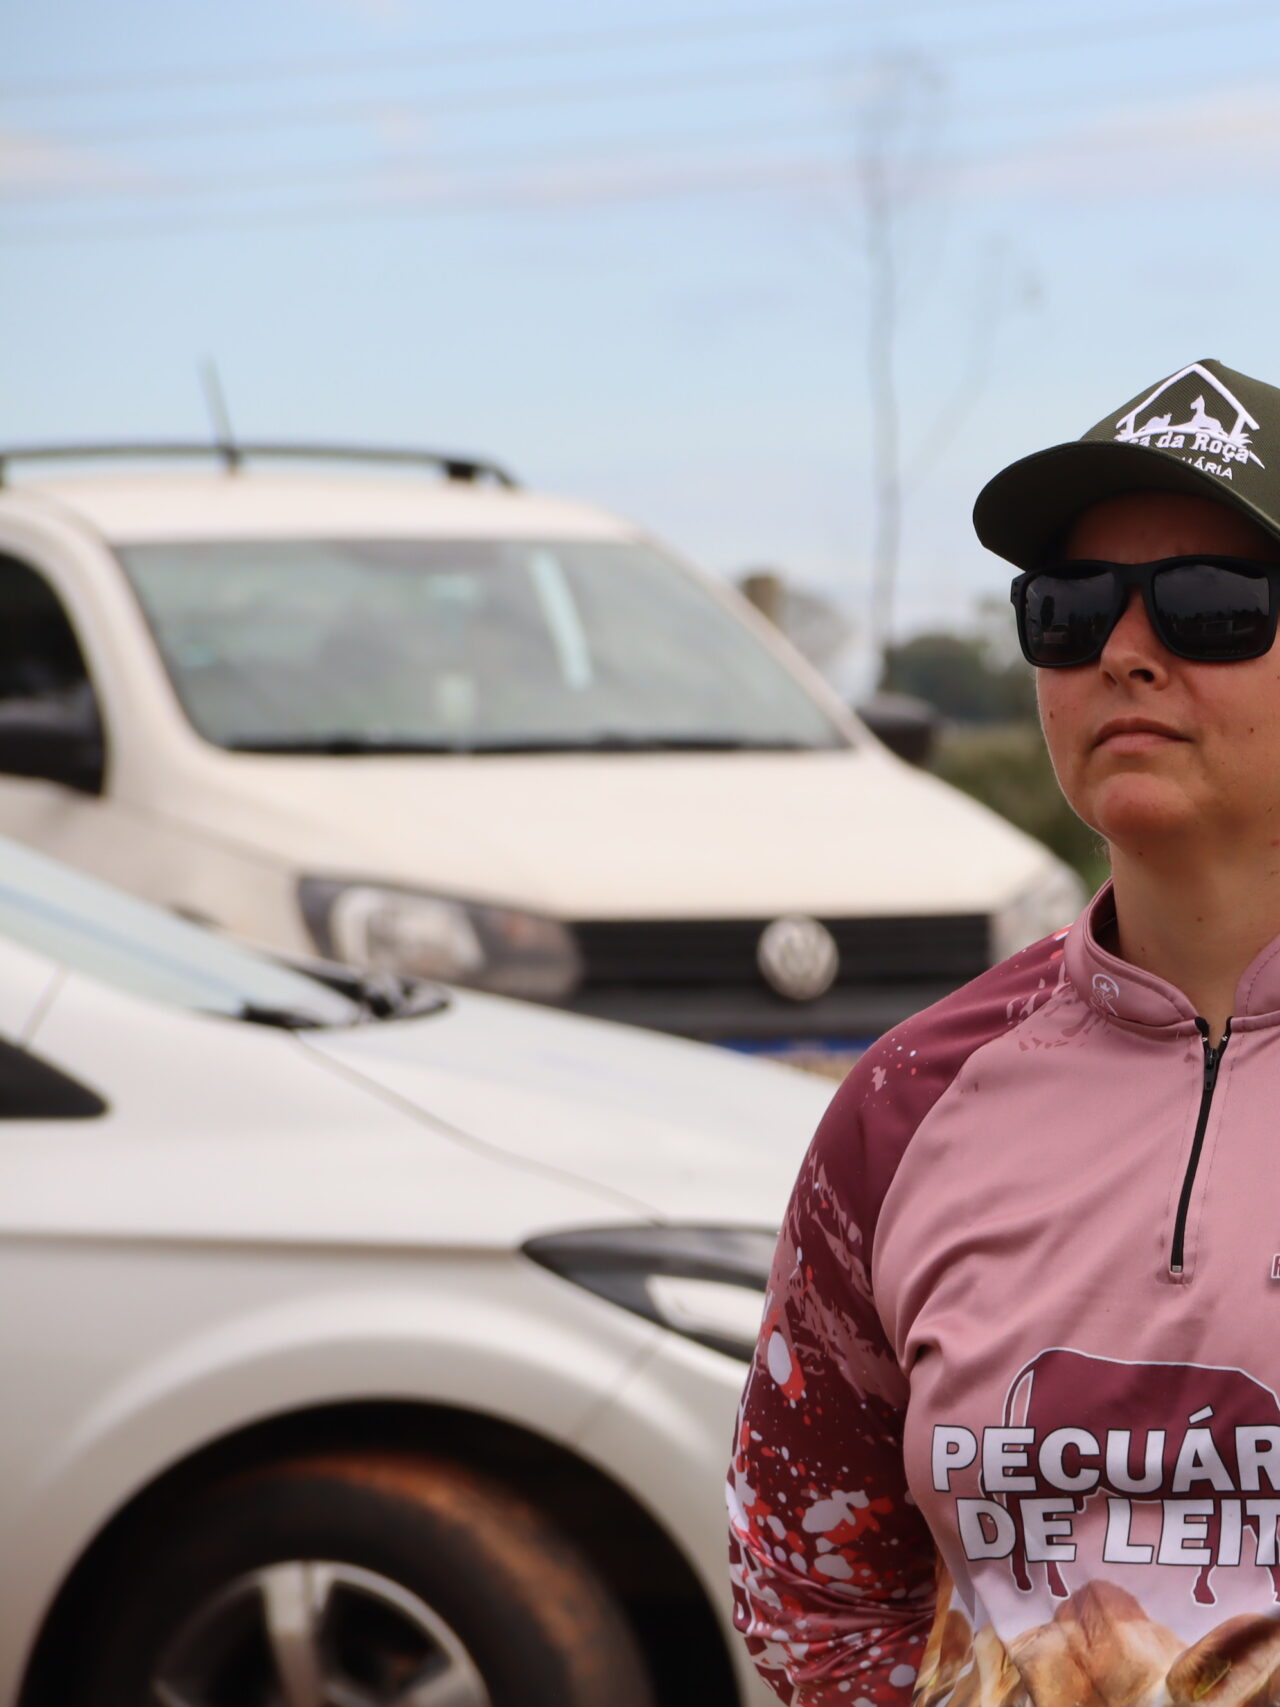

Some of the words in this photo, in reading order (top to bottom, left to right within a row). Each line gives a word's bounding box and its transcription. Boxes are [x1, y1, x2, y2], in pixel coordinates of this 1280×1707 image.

[1155, 431, 1185, 449] da
[1189, 431, 1249, 464] Roça
[956, 1497, 1078, 1563] DE
